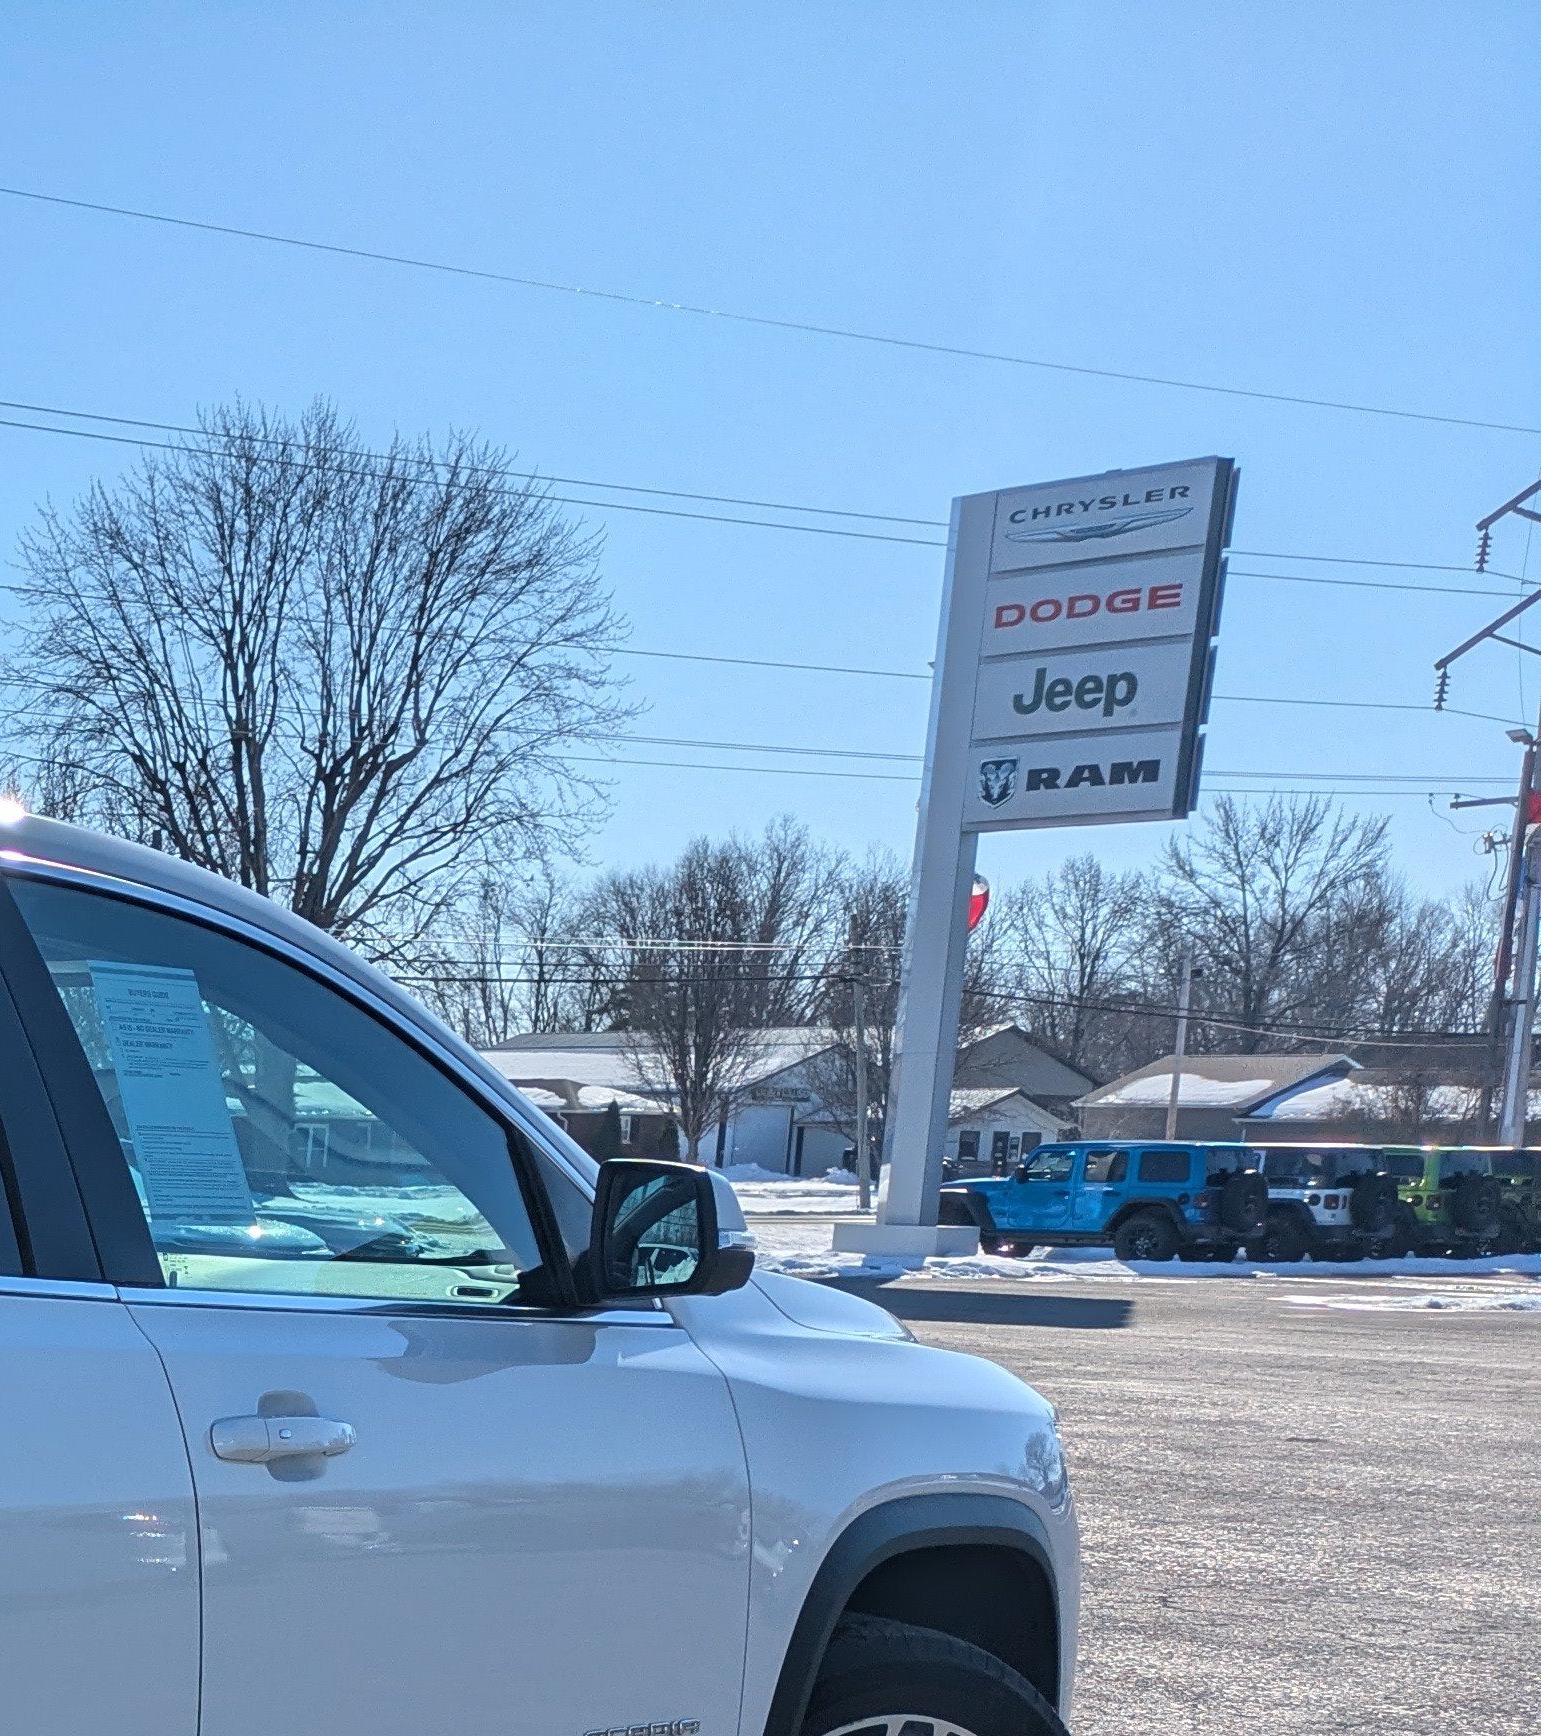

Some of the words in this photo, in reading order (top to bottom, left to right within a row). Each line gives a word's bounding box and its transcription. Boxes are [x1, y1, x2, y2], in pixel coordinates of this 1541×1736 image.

[1008, 484, 1192, 524] CHRYSLER
[993, 582, 1184, 630] DODGE
[1012, 666, 1140, 719] Jeep
[1024, 757, 1163, 793] RAM
